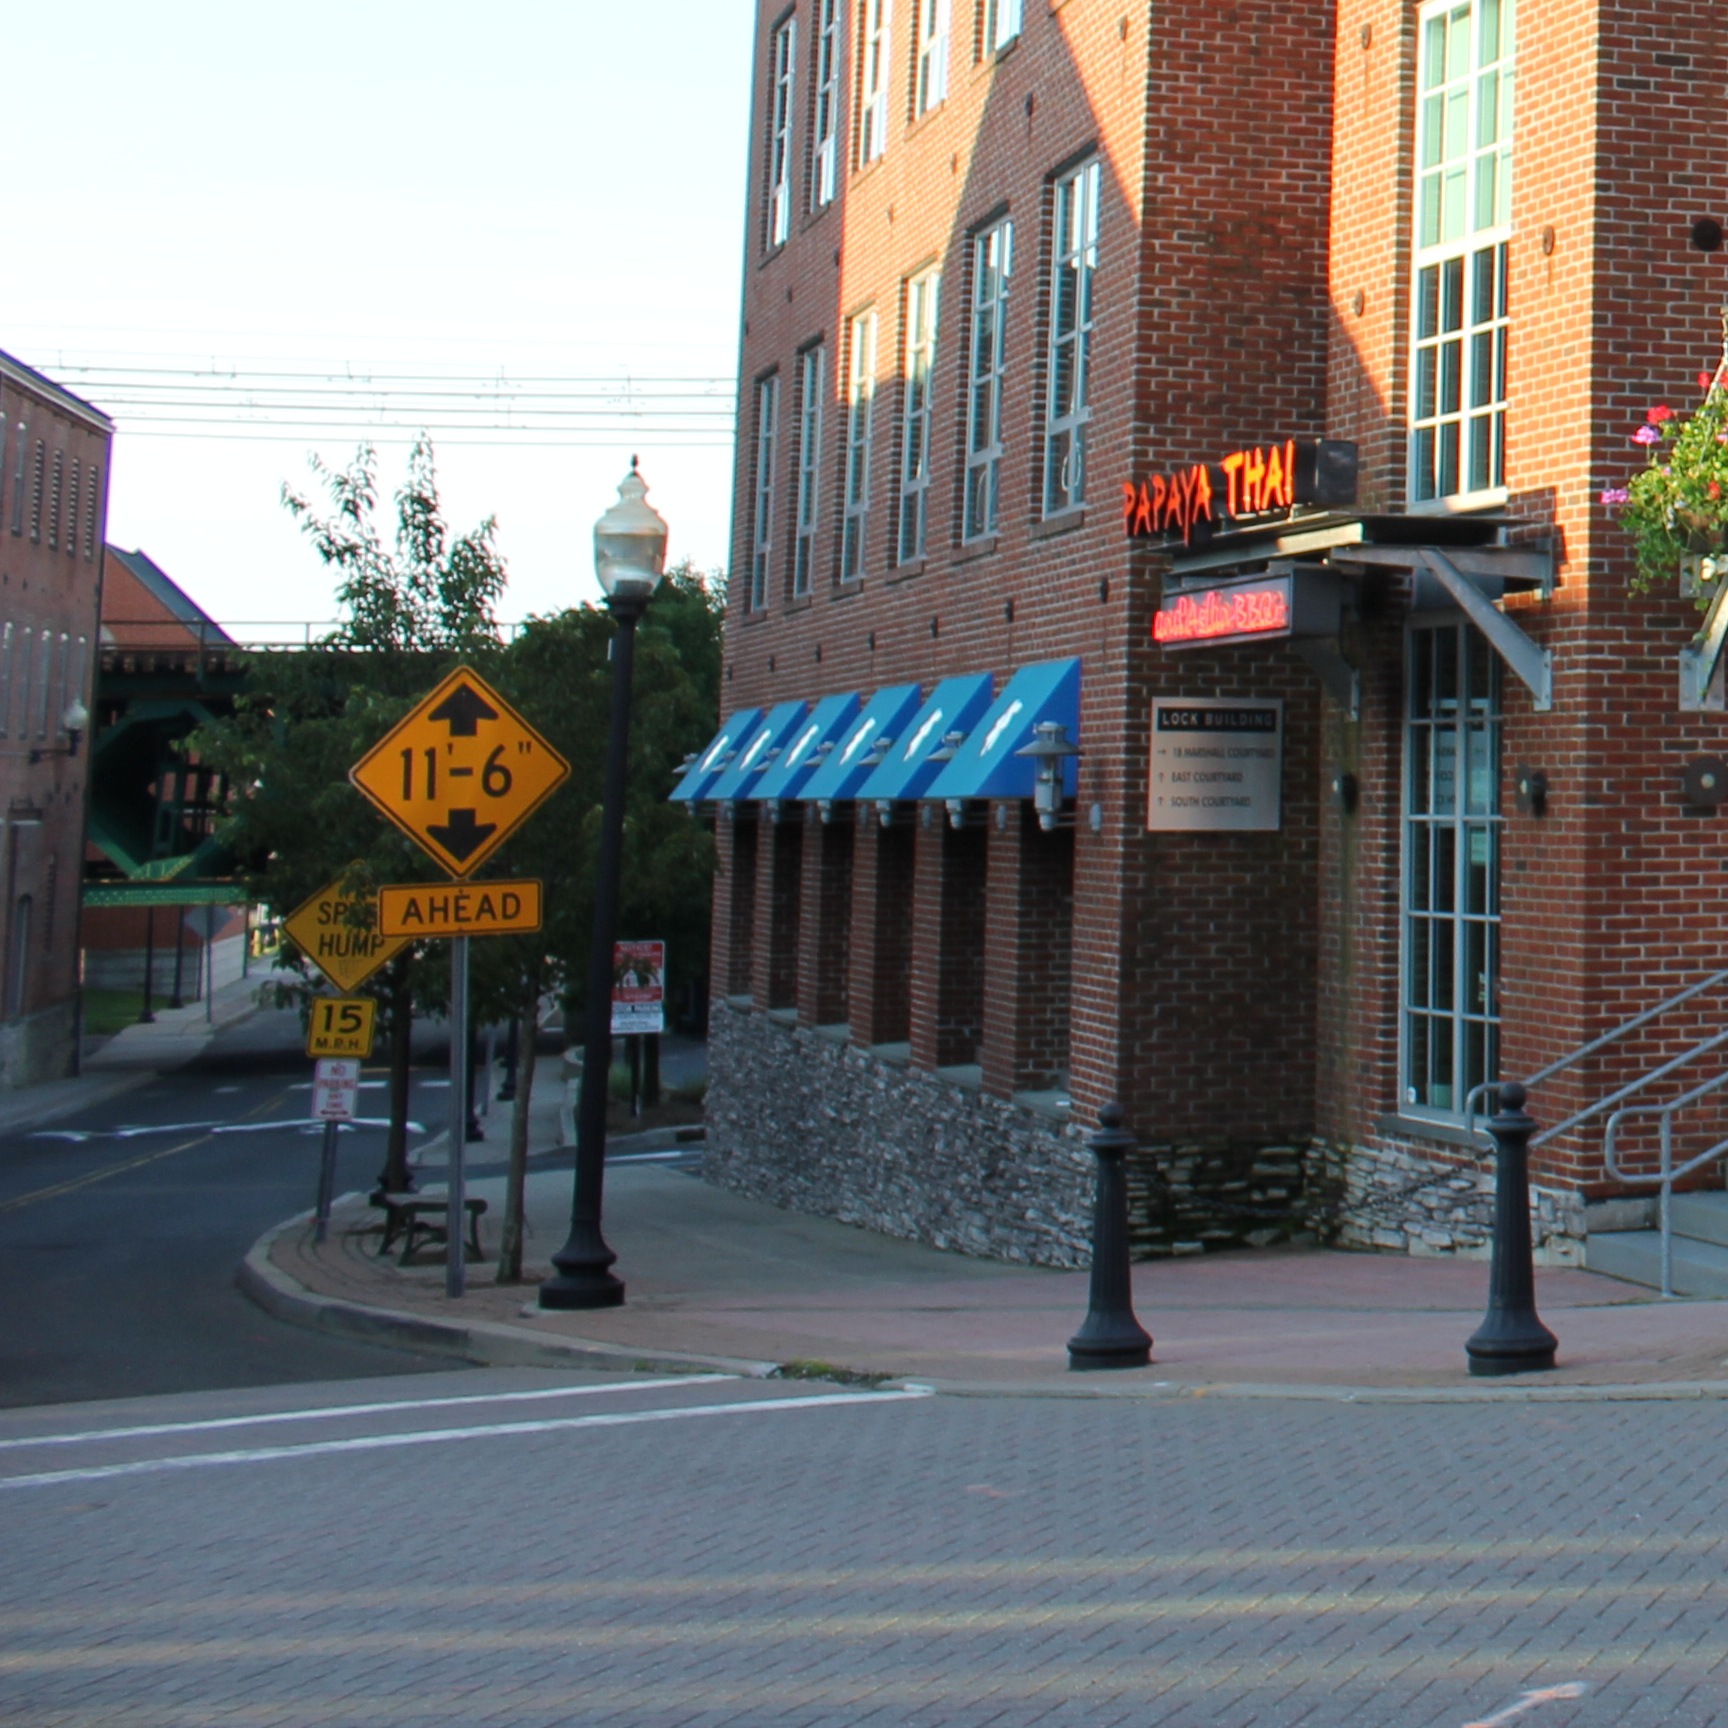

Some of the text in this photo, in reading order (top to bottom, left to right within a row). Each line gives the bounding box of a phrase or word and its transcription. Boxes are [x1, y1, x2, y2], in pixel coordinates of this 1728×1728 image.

[1122, 438, 1294, 547] PAPAYA THAI
[1162, 713, 1273, 726] LOCK BUILDING
[1227, 747, 1275, 758] COURTYARD
[1171, 772, 1244, 783] EAST COURTYARD
[1171, 796, 1251, 807] SOUTH COURTYARD
[401, 892, 521, 926] AHEAD
[318, 932, 385, 958] HUMP
[323, 1003, 363, 1035] 15
[330, 1065, 346, 1076] NO
